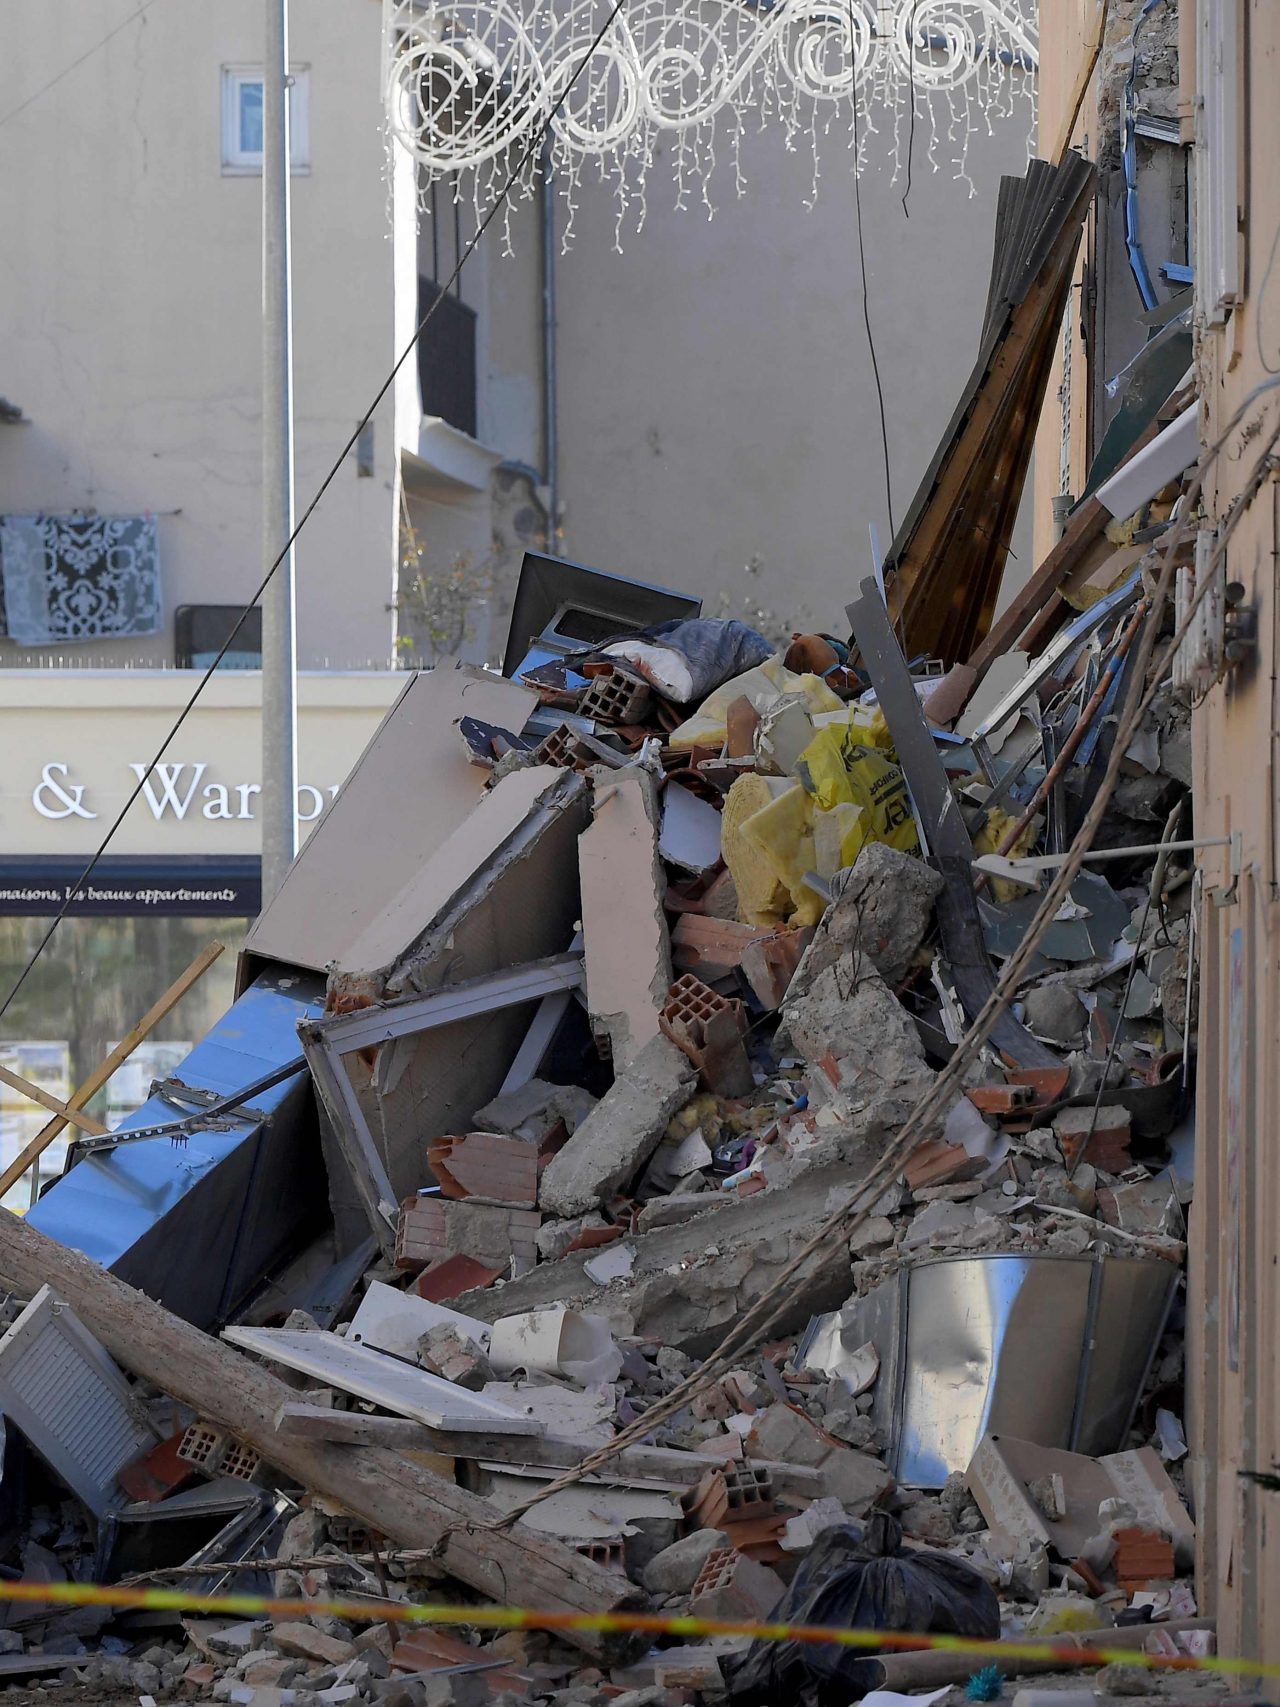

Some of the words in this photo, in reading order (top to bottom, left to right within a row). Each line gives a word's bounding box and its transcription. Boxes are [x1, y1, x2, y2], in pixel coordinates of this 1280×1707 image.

[31, 762, 98, 819] &
[128, 763, 340, 821] Waro
[884, 794, 912, 835] er
[87, 886, 134, 900] beaux
[136, 887, 236, 904] appartements
